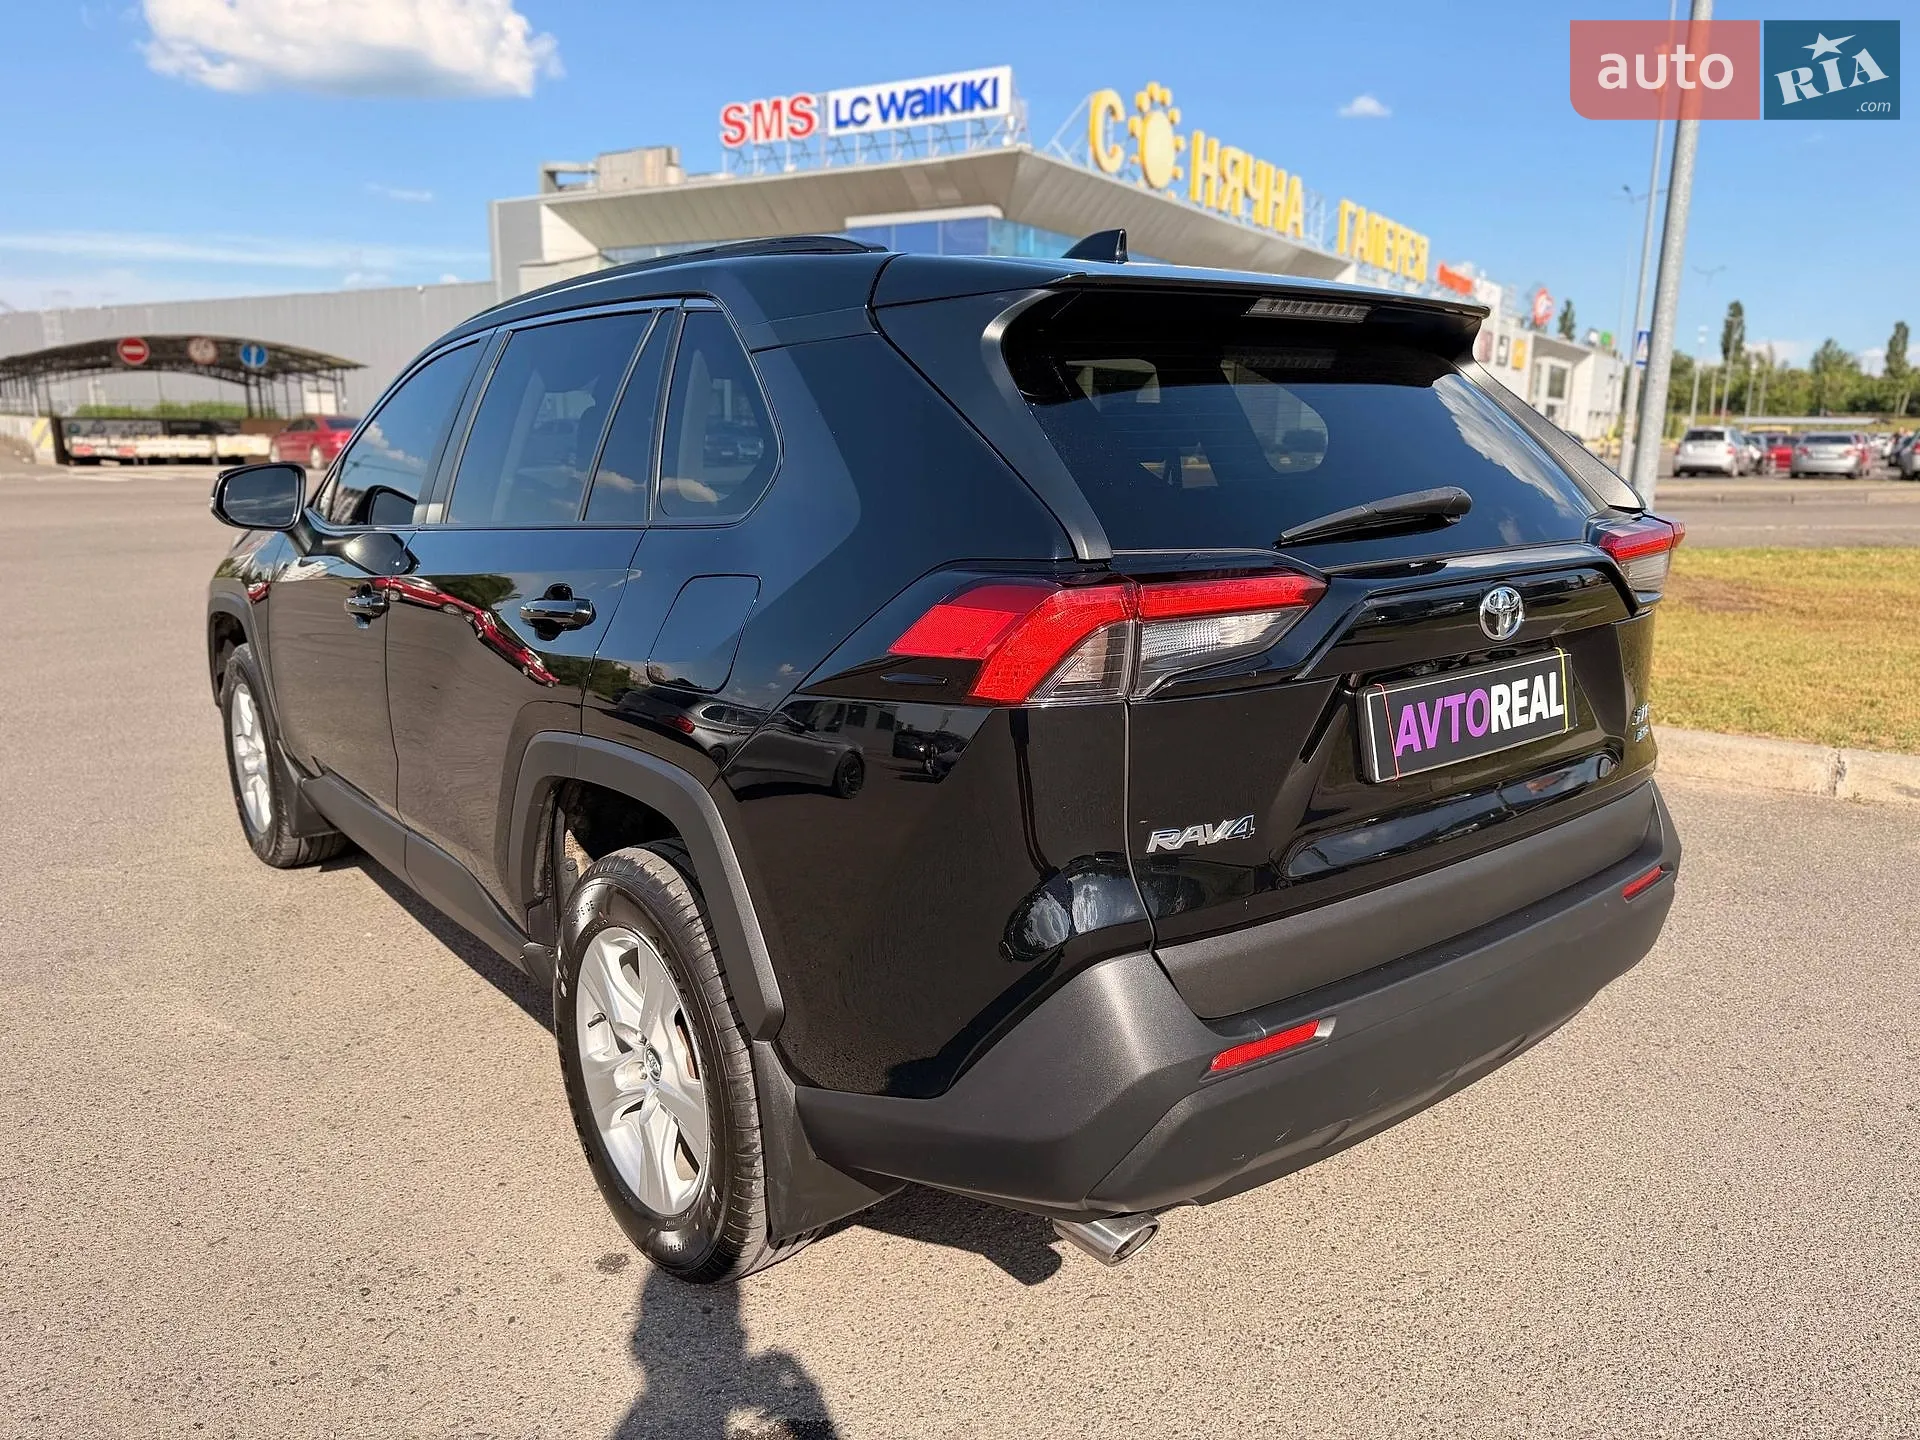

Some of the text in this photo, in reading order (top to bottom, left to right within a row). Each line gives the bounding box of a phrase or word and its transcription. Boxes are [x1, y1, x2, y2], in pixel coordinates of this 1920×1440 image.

[721, 93, 817, 146] SMS
[834, 96, 871, 128] LC
[1395, 671, 1565, 758] AVTOREAL
[1146, 814, 1256, 854] RAV4
